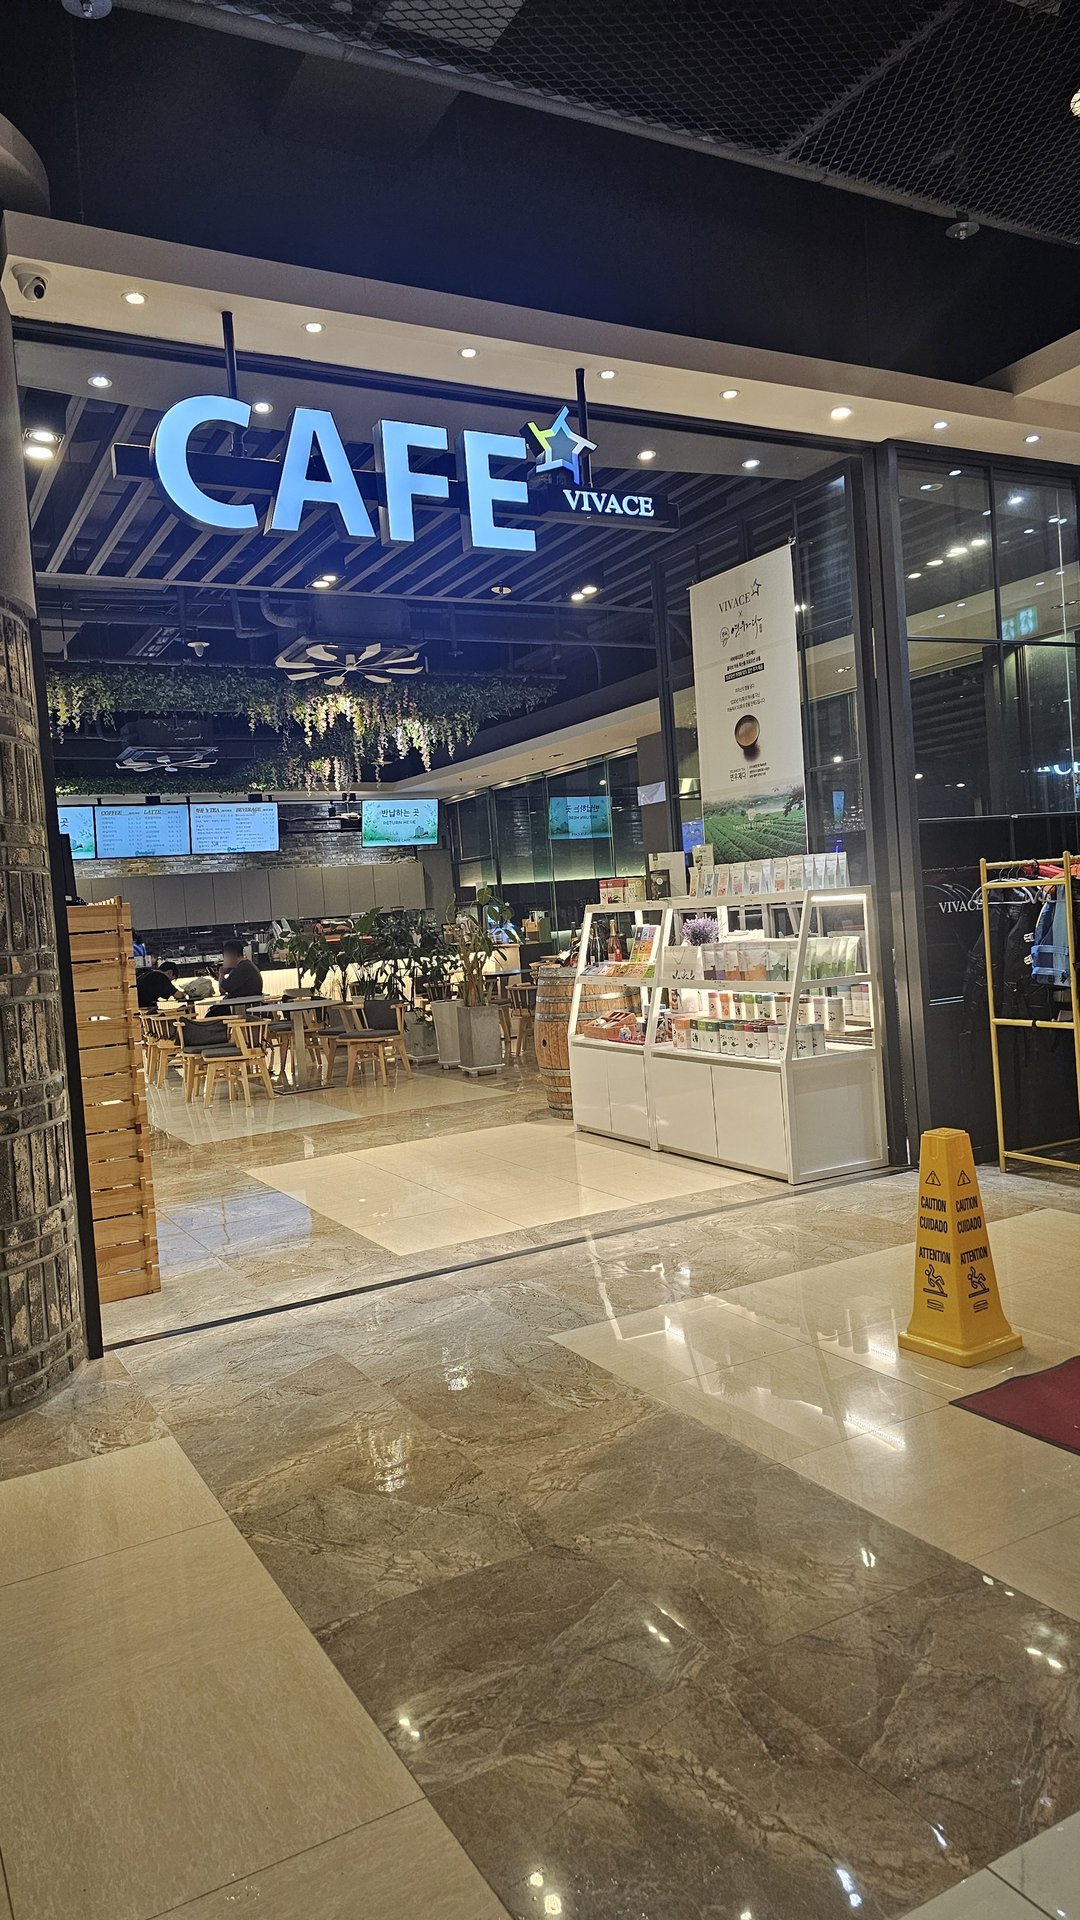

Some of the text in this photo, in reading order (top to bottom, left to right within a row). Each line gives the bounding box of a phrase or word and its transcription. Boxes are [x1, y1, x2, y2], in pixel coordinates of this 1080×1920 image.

[153, 394, 537, 552] CAFE
[562, 489, 655, 517] VIVACE
[718, 592, 751, 613] VIVACE
[730, 772, 746, 782] 연우제다
[381, 808, 420, 818] 반납하는 곳
[920, 1195, 946, 1213] CAUTION
[955, 1195, 978, 1213] CAUTION
[919, 1216, 948, 1234] CUIDADO
[956, 1216, 982, 1234] CUIDADO
[918, 1246, 951, 1265] ATTENTION
[960, 1245, 989, 1265] ATTENTION
